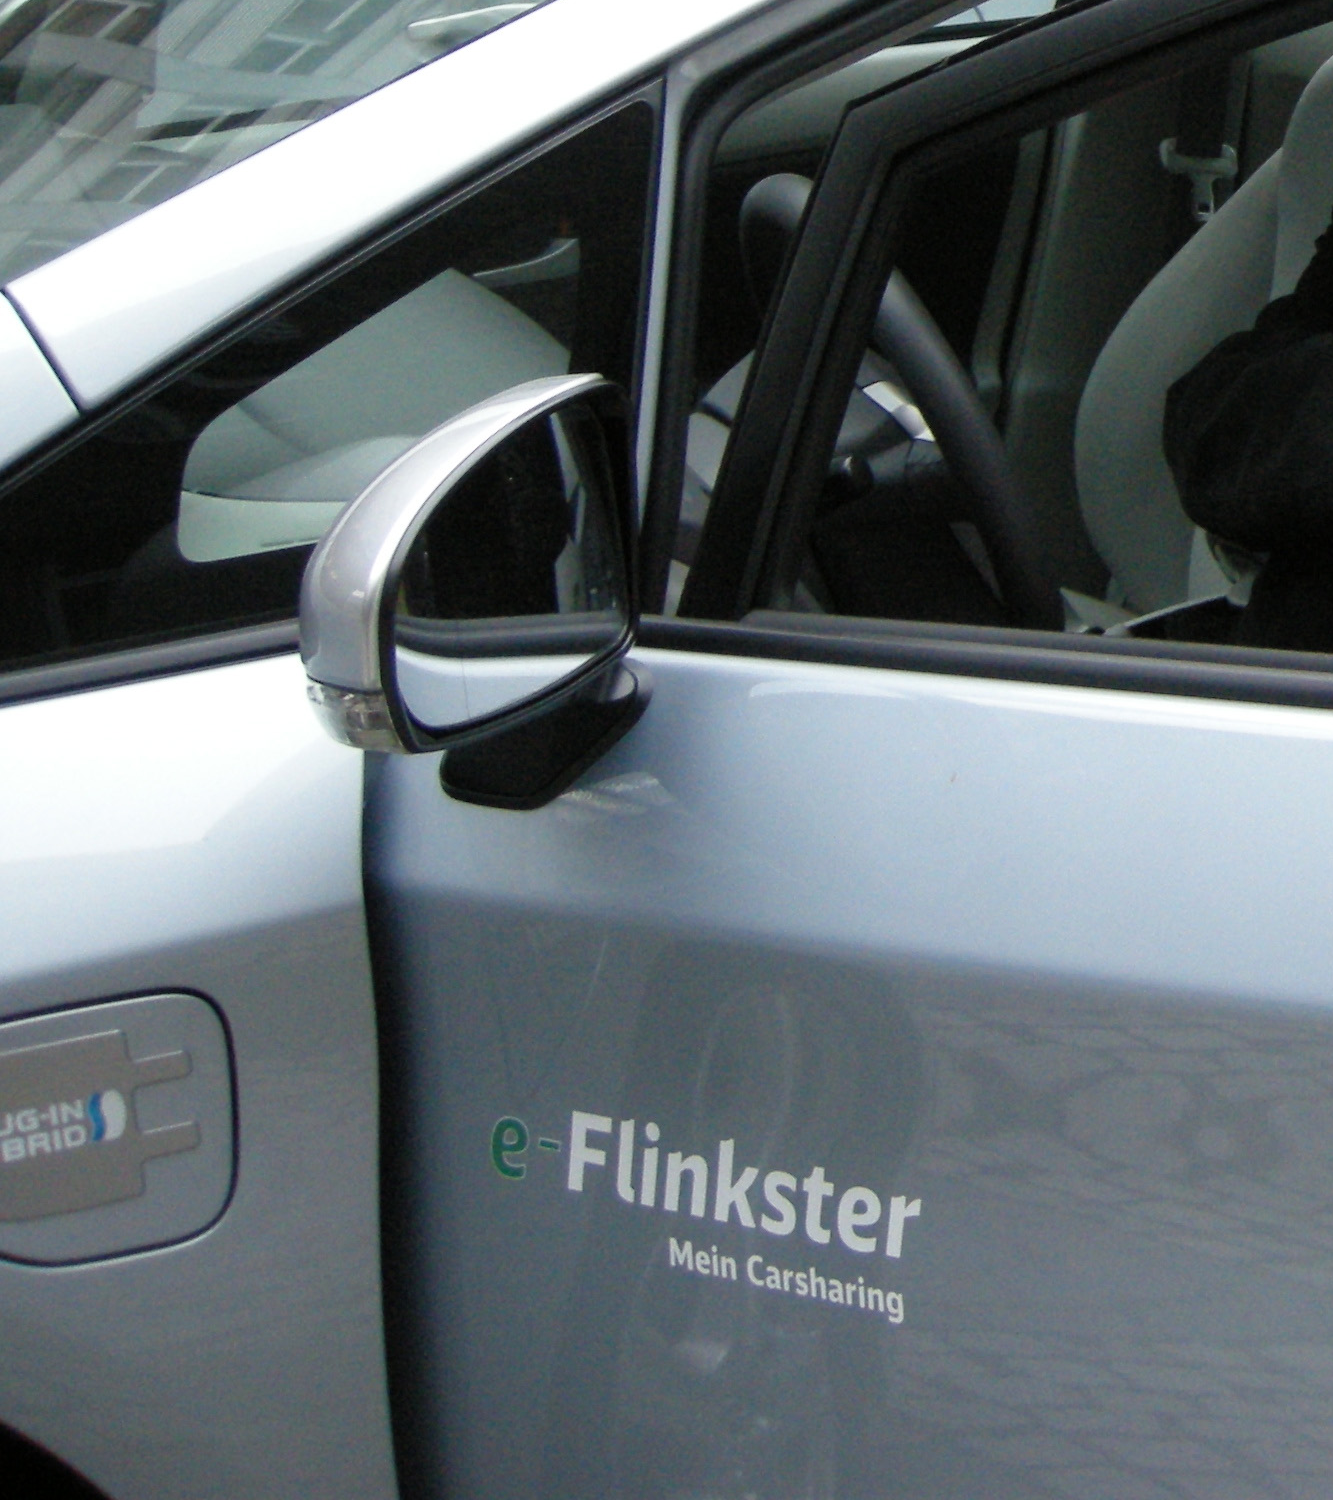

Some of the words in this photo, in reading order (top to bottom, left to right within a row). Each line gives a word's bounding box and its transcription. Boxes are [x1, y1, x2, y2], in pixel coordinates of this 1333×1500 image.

[491, 1110, 922, 1258] e-Flinkster
[669, 1237, 738, 1281] Mein
[746, 1255, 905, 1324] Carsharing
